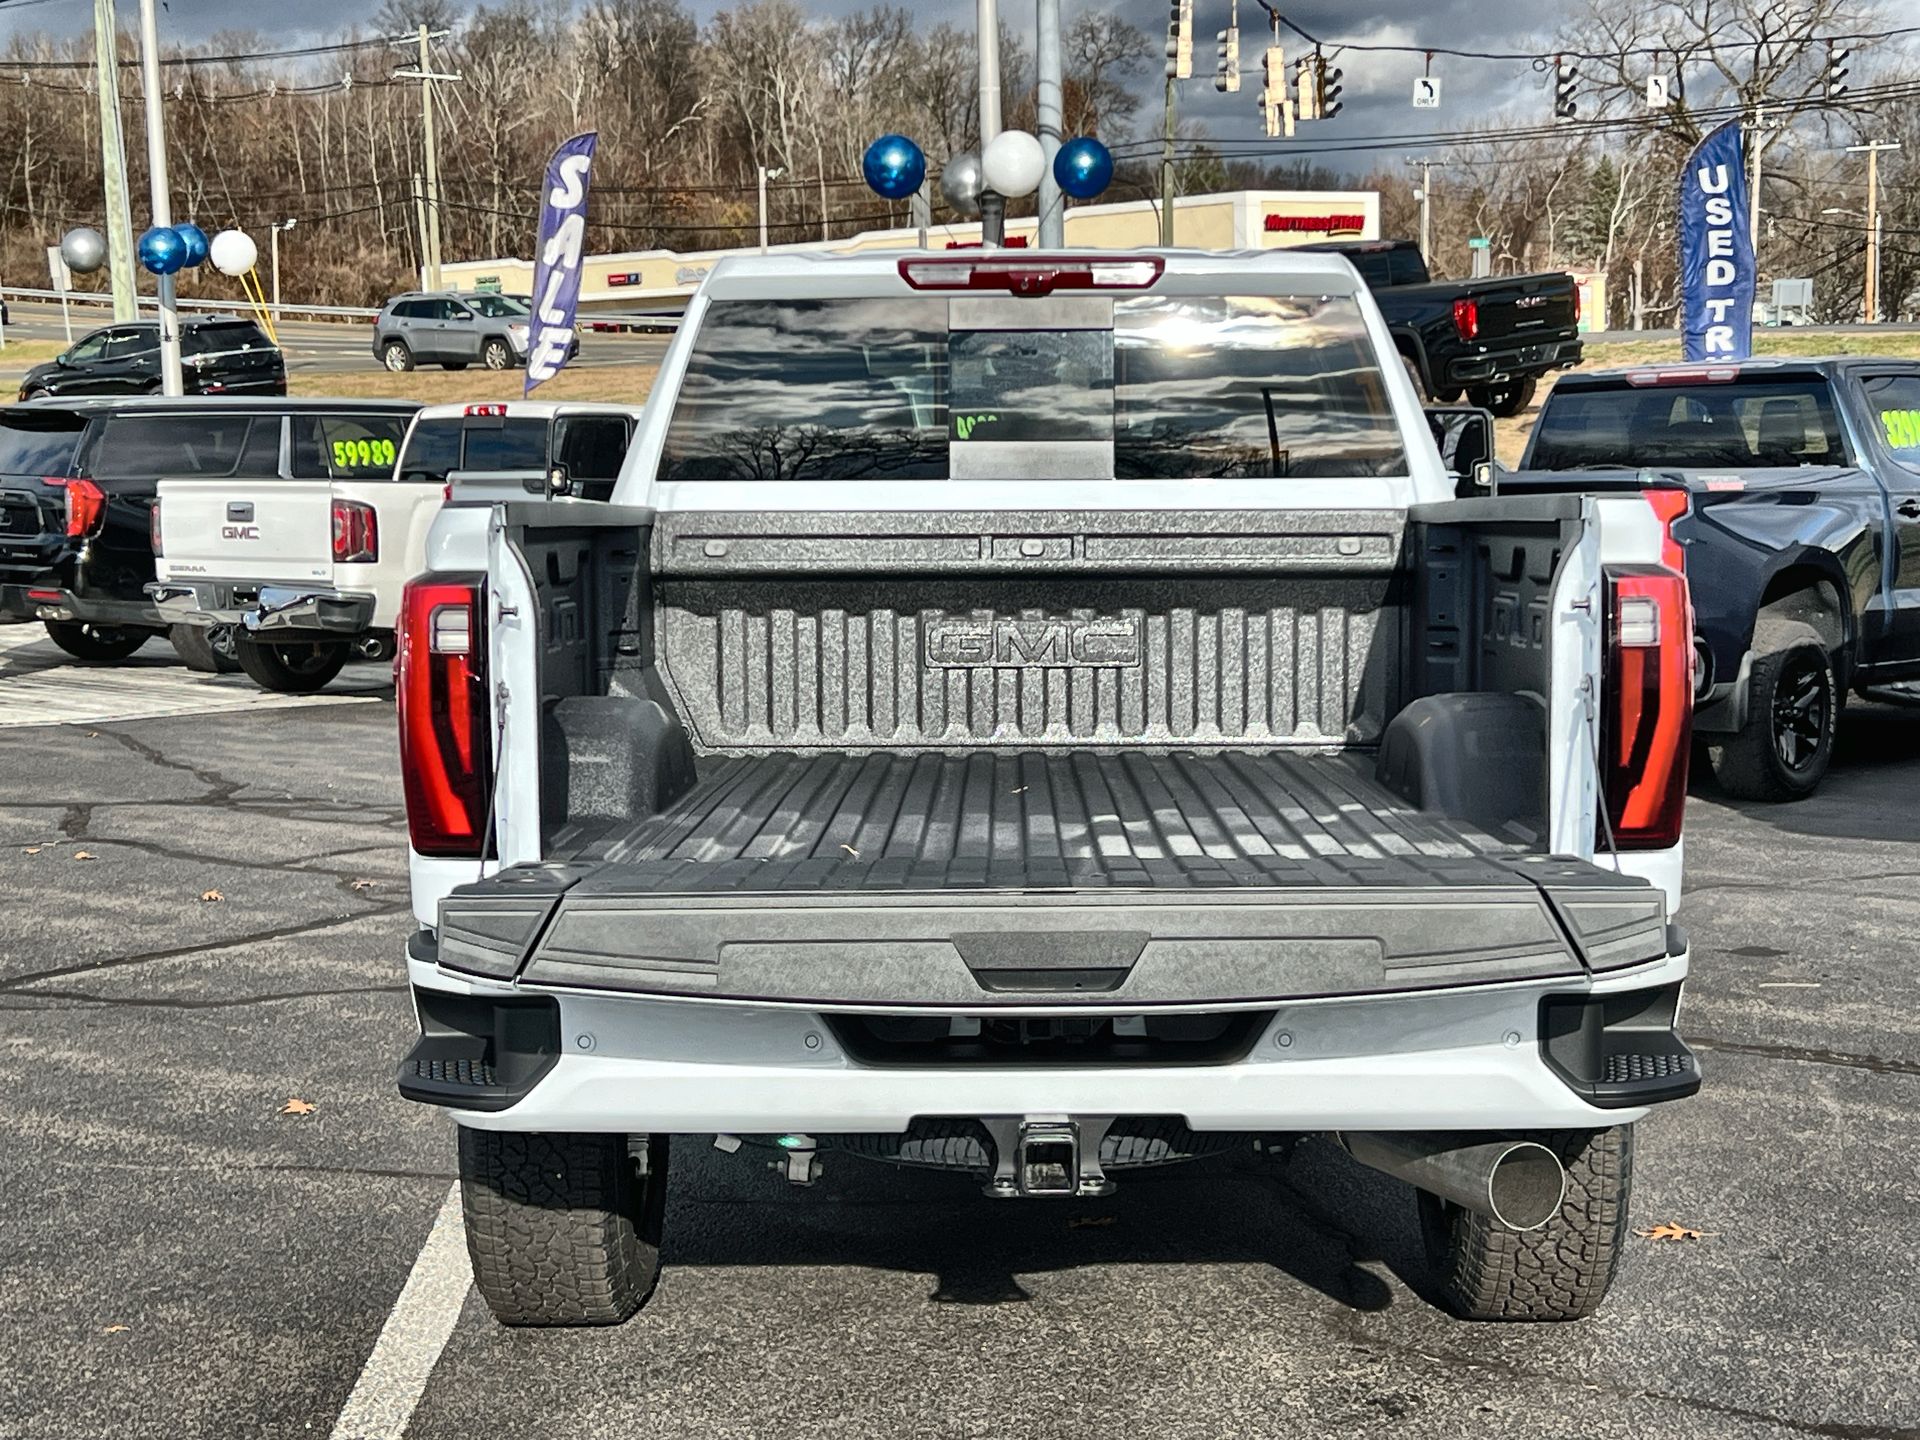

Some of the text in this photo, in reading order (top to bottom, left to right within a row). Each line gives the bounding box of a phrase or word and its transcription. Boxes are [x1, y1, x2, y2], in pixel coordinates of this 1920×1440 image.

[1416, 97, 1435, 106] ONLY
[528, 154, 591, 380] SALE
[1697, 164, 1736, 361] USED TR
[333, 439, 395, 468] 59989
[221, 526, 260, 540] GMC
[928, 623, 1137, 663] GMC
